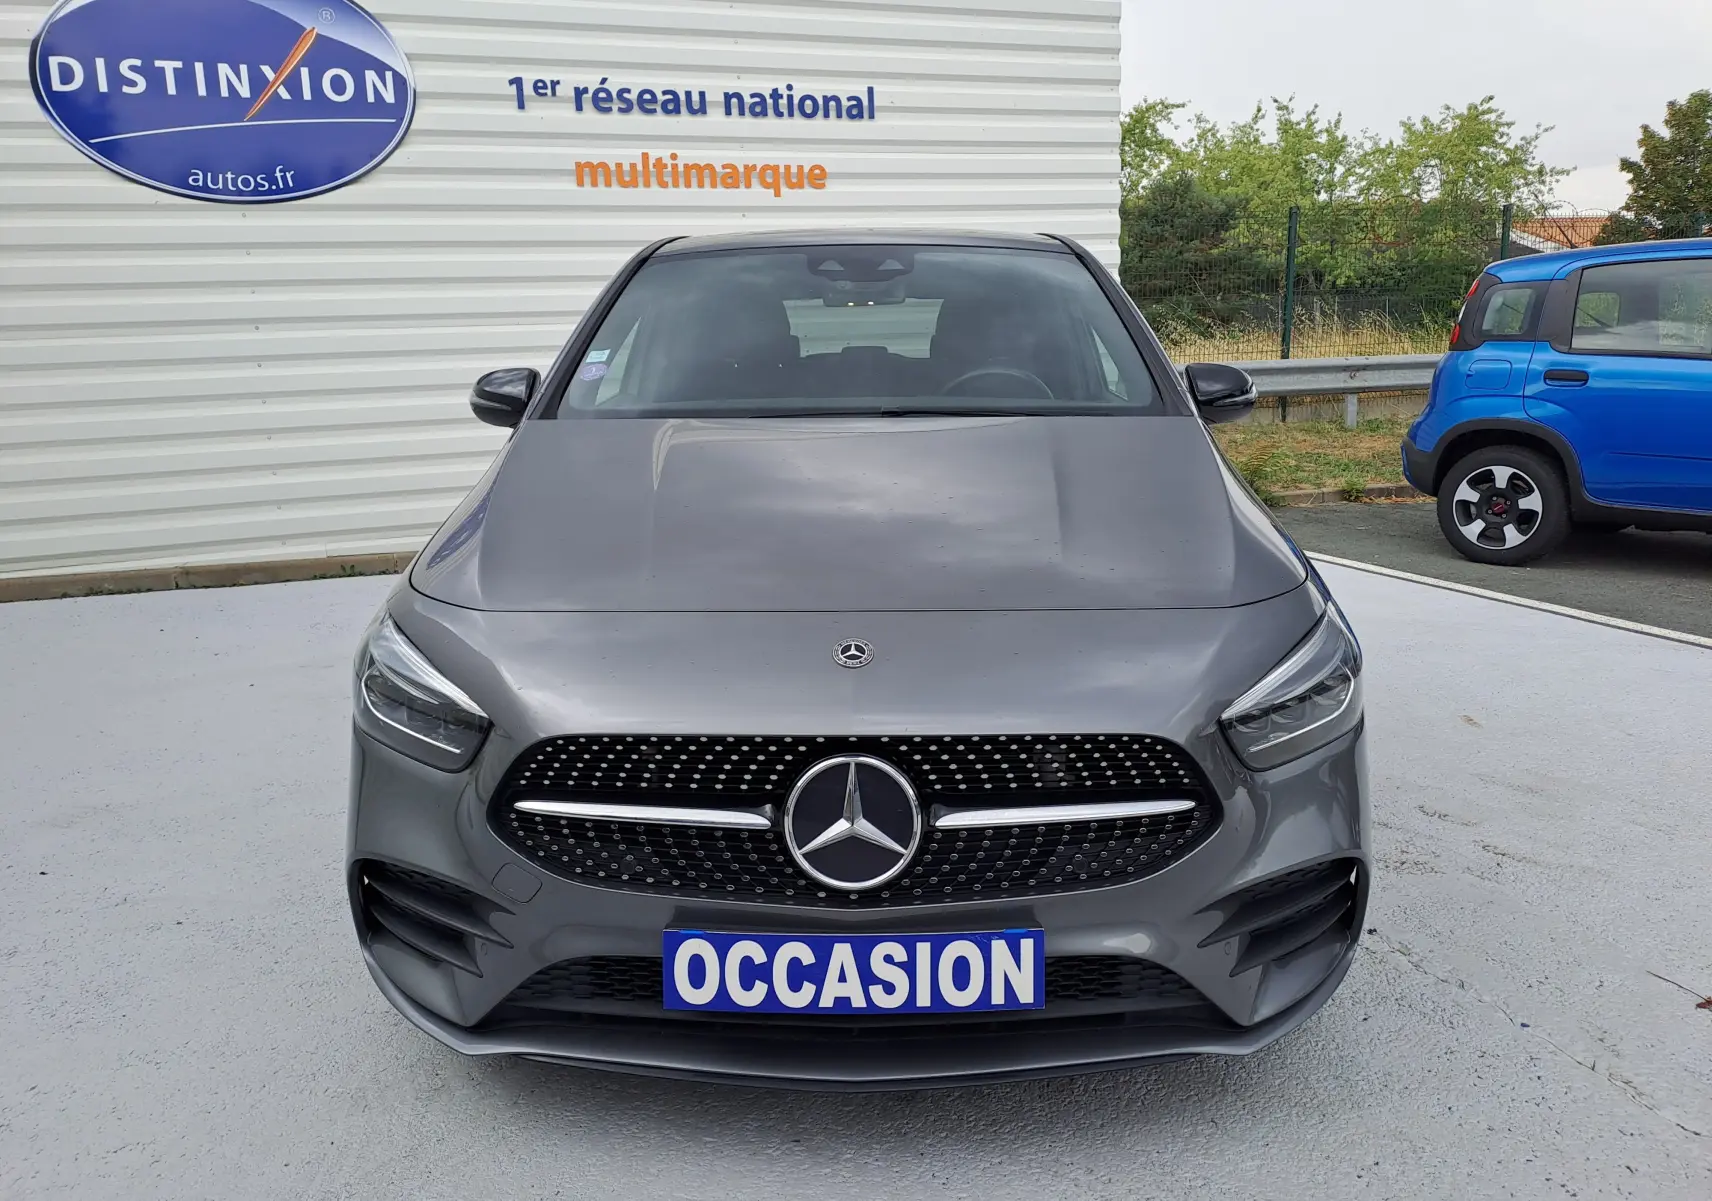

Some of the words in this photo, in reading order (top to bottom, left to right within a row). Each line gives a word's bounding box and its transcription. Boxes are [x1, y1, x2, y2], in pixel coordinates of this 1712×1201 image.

[48, 44, 396, 112] DISTINXION
[573, 77, 708, 116] réseau
[723, 83, 875, 120] national
[187, 165, 295, 192] autos.fr
[574, 152, 828, 198] multimarque
[673, 938, 1034, 1008] OCCASION
